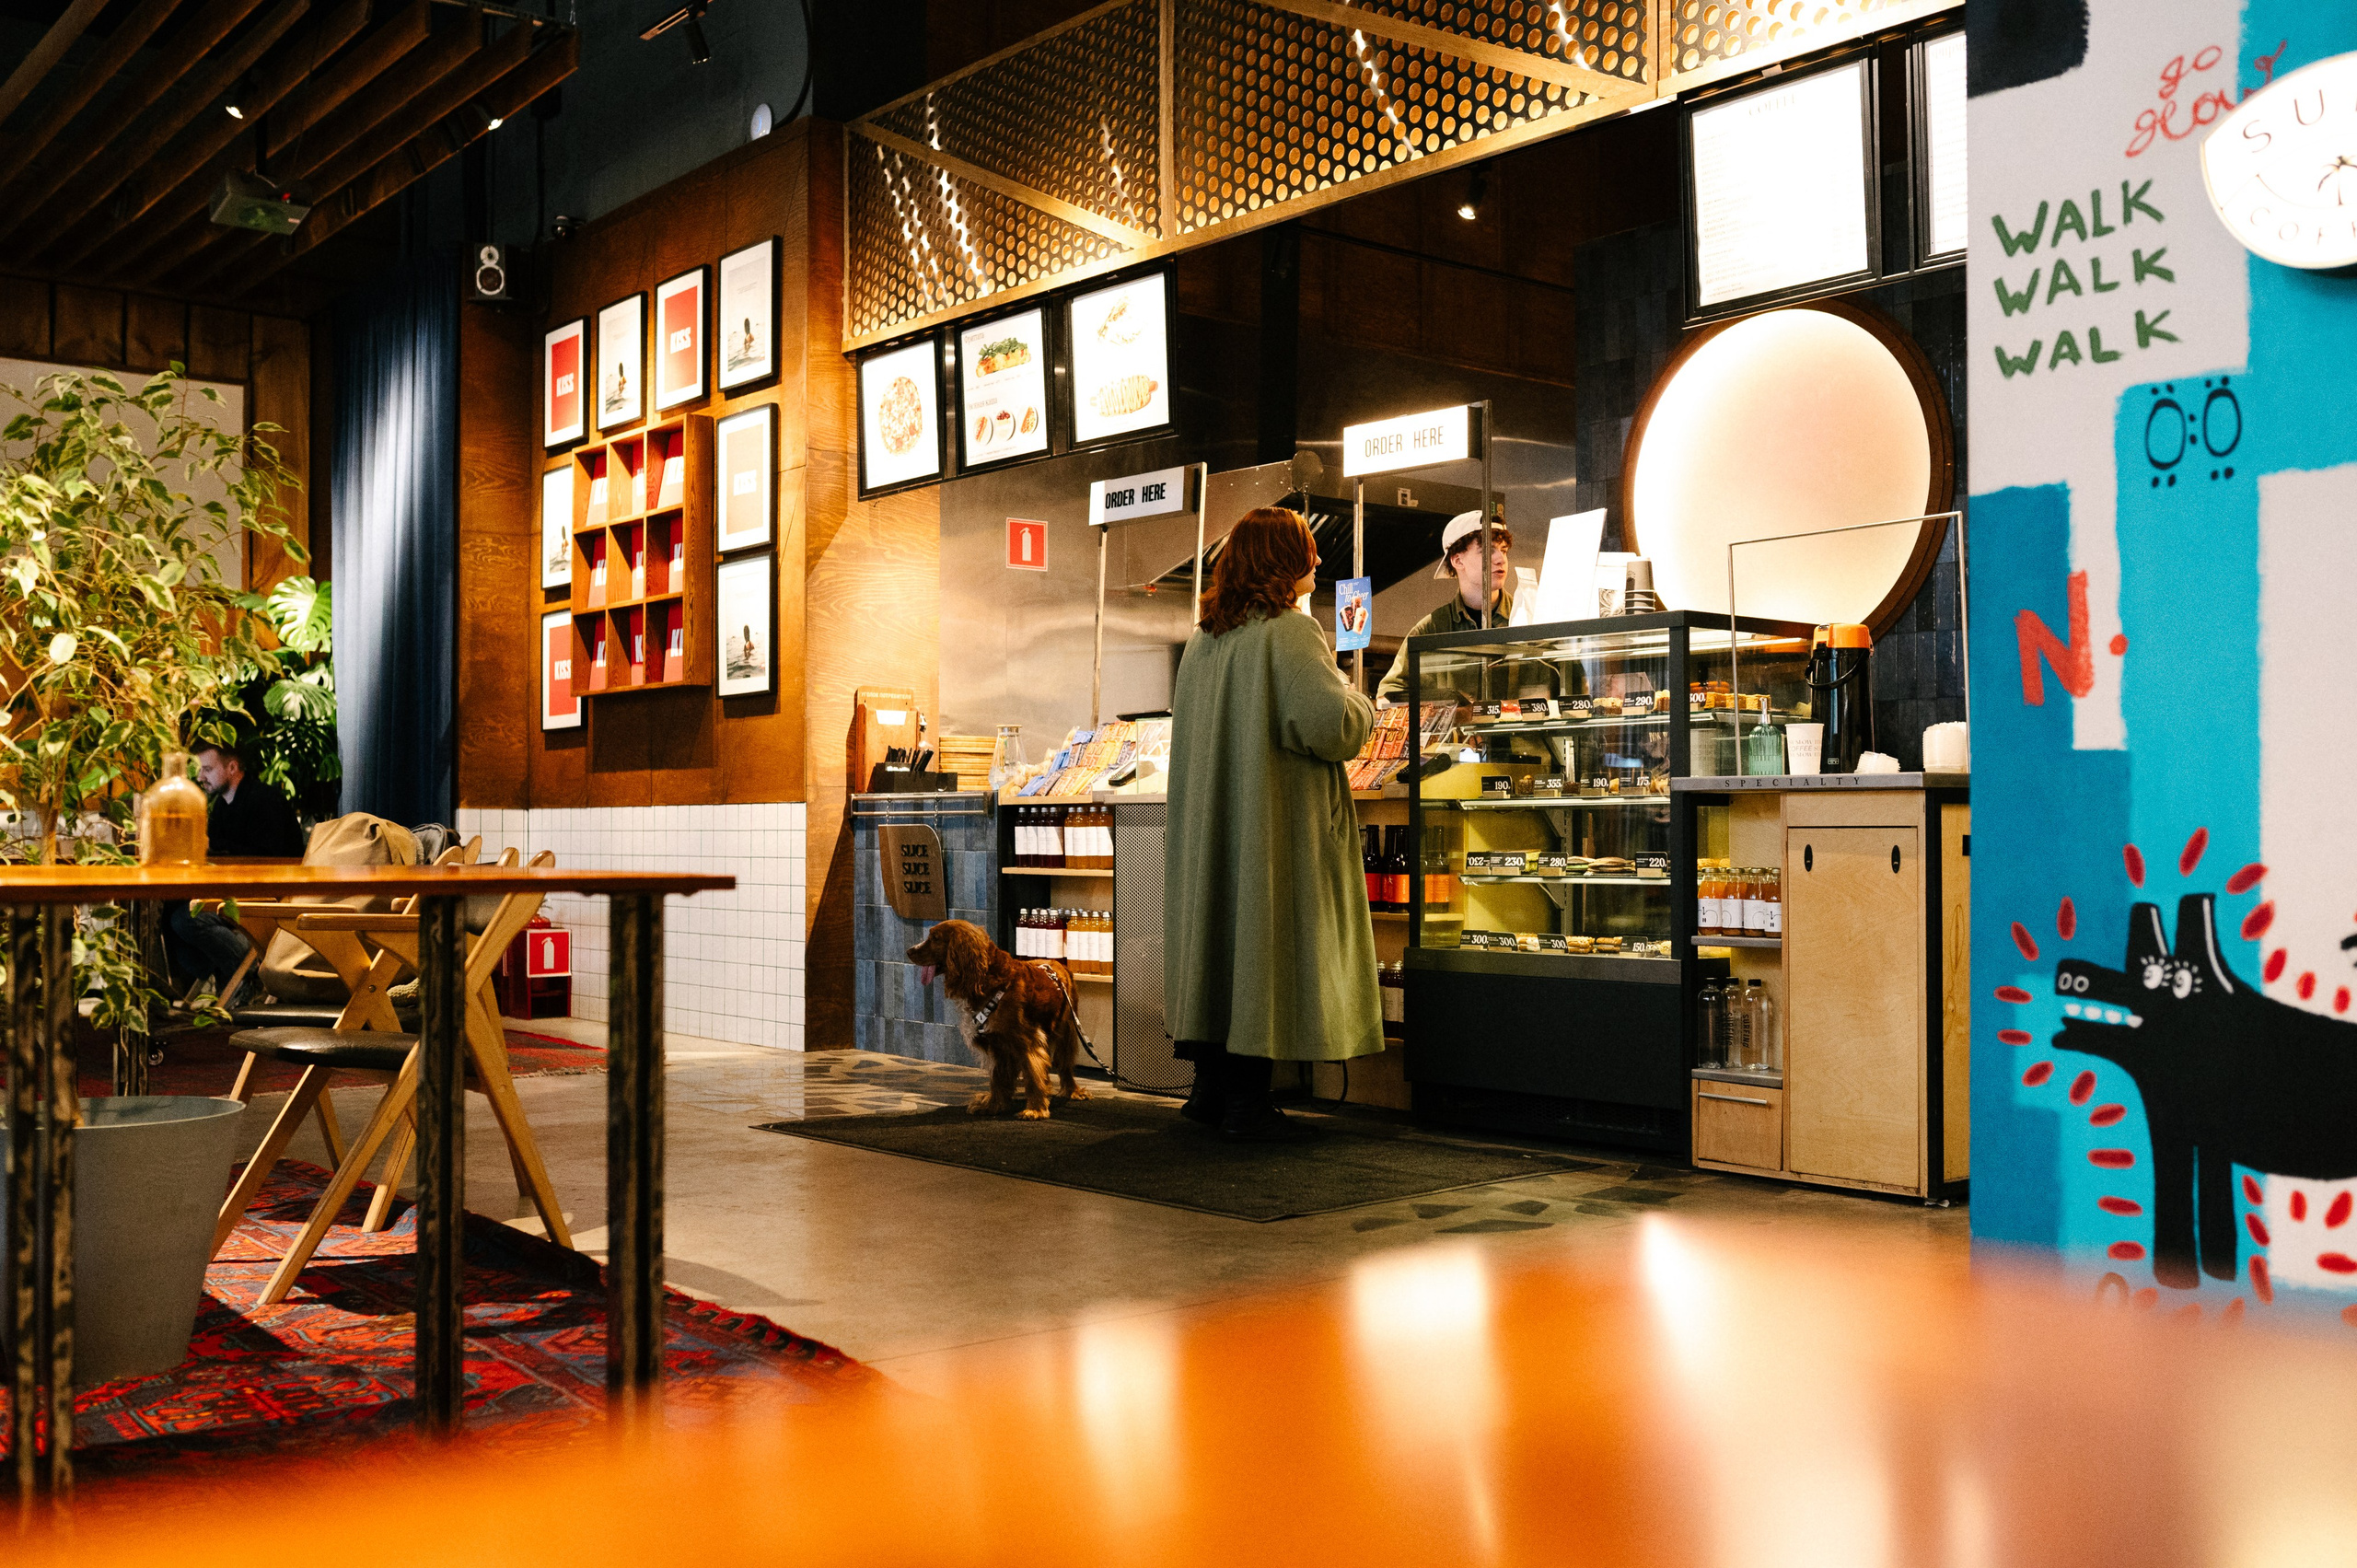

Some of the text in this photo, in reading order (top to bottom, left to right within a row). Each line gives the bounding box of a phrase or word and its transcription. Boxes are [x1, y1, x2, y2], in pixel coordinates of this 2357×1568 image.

[2158, 44, 2223, 100] go
[2242, 88, 2357, 154] SU
[1991, 178, 2165, 258] WALK
[2249, 205, 2357, 247] COF
[1992, 245, 2176, 318] WALK
[669, 326, 691, 354] KISS
[1993, 308, 2182, 380] WALK
[556, 372, 575, 398] KISS
[1364, 425, 1445, 458] ORDER HERE
[1105, 482, 1167, 510] ORDER HERE
[1339, 582, 1353, 596] Chill
[1572, 700, 1591, 710] 280
[1634, 695, 1652, 706] 290
[1546, 778, 1562, 788] 355
[1593, 777, 1607, 787] 190
[1636, 776, 1649, 786] 175
[1724, 776, 1860, 787] SPECIALTY
[900, 843, 929, 857] SLICE
[1504, 856, 1523, 866] 230
[1549, 857, 1565, 867] 280
[1648, 857, 1666, 867] 220
[902, 862, 930, 875] SLICE
[903, 881, 932, 894] SLICE
[1742, 1014, 1750, 1049] SURFING
